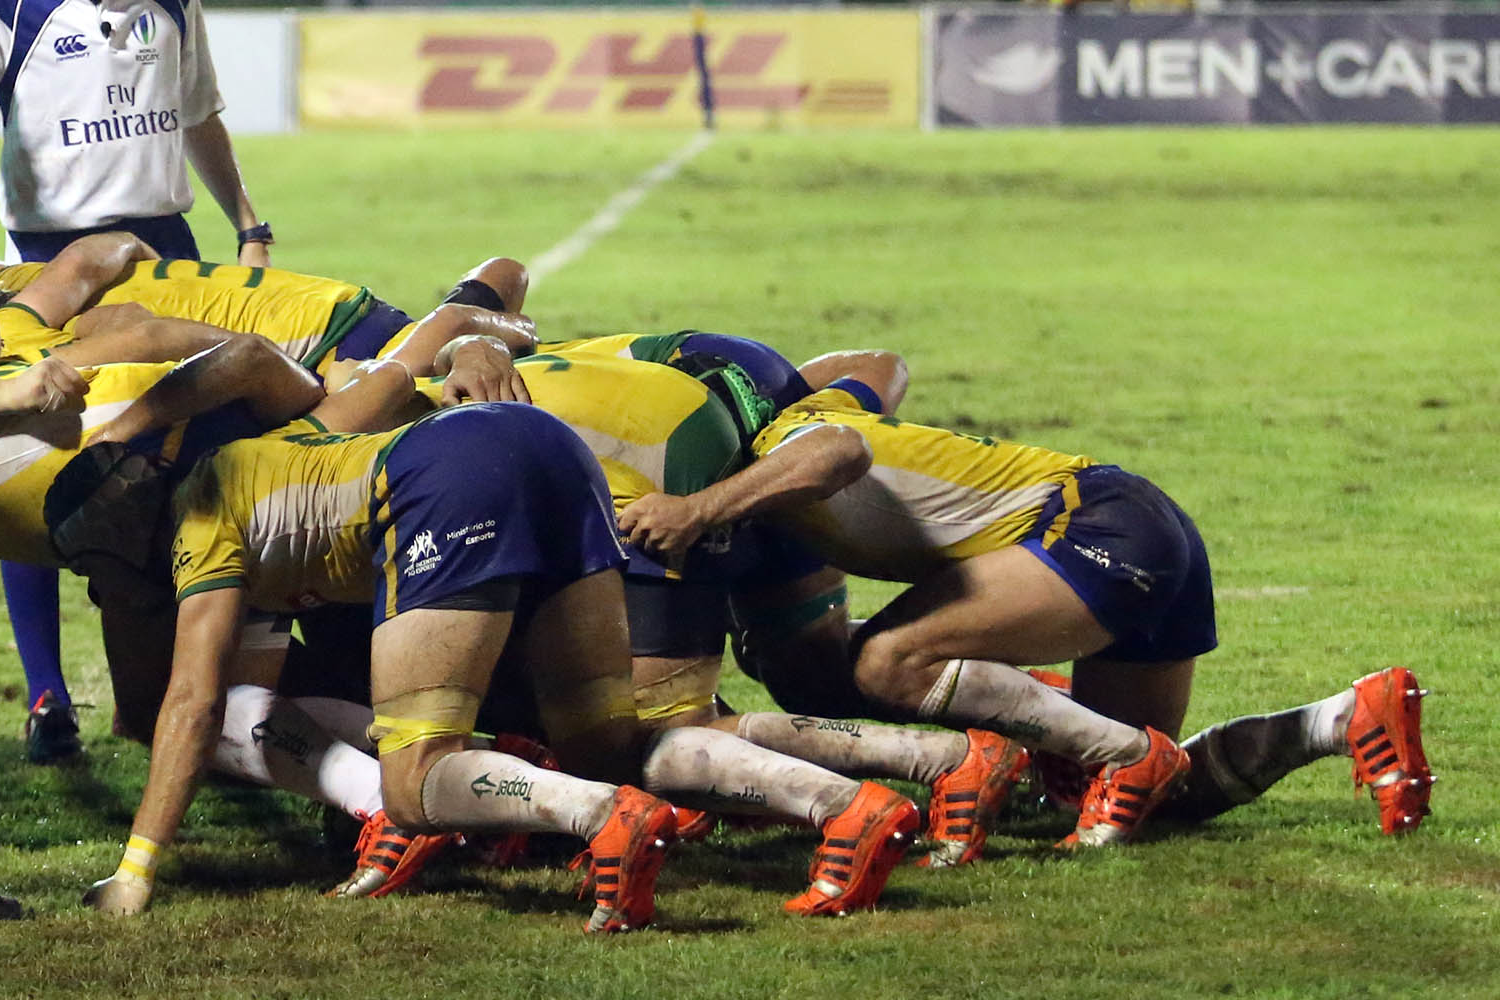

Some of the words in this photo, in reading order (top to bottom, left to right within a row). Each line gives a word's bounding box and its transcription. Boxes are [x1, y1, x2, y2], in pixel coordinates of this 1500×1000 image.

[135, 54, 160, 62] RUGBY
[1075, 38, 1500, 99] MEN+CAR
[415, 32, 798, 113] DHL
[106, 84, 136, 107] Fly
[59, 108, 179, 147] Emirates
[446, 522, 484, 541] Ministrio
[484, 519, 496, 528] do
[817, 720, 862, 738] Topper
[495, 776, 534, 801] Topper
